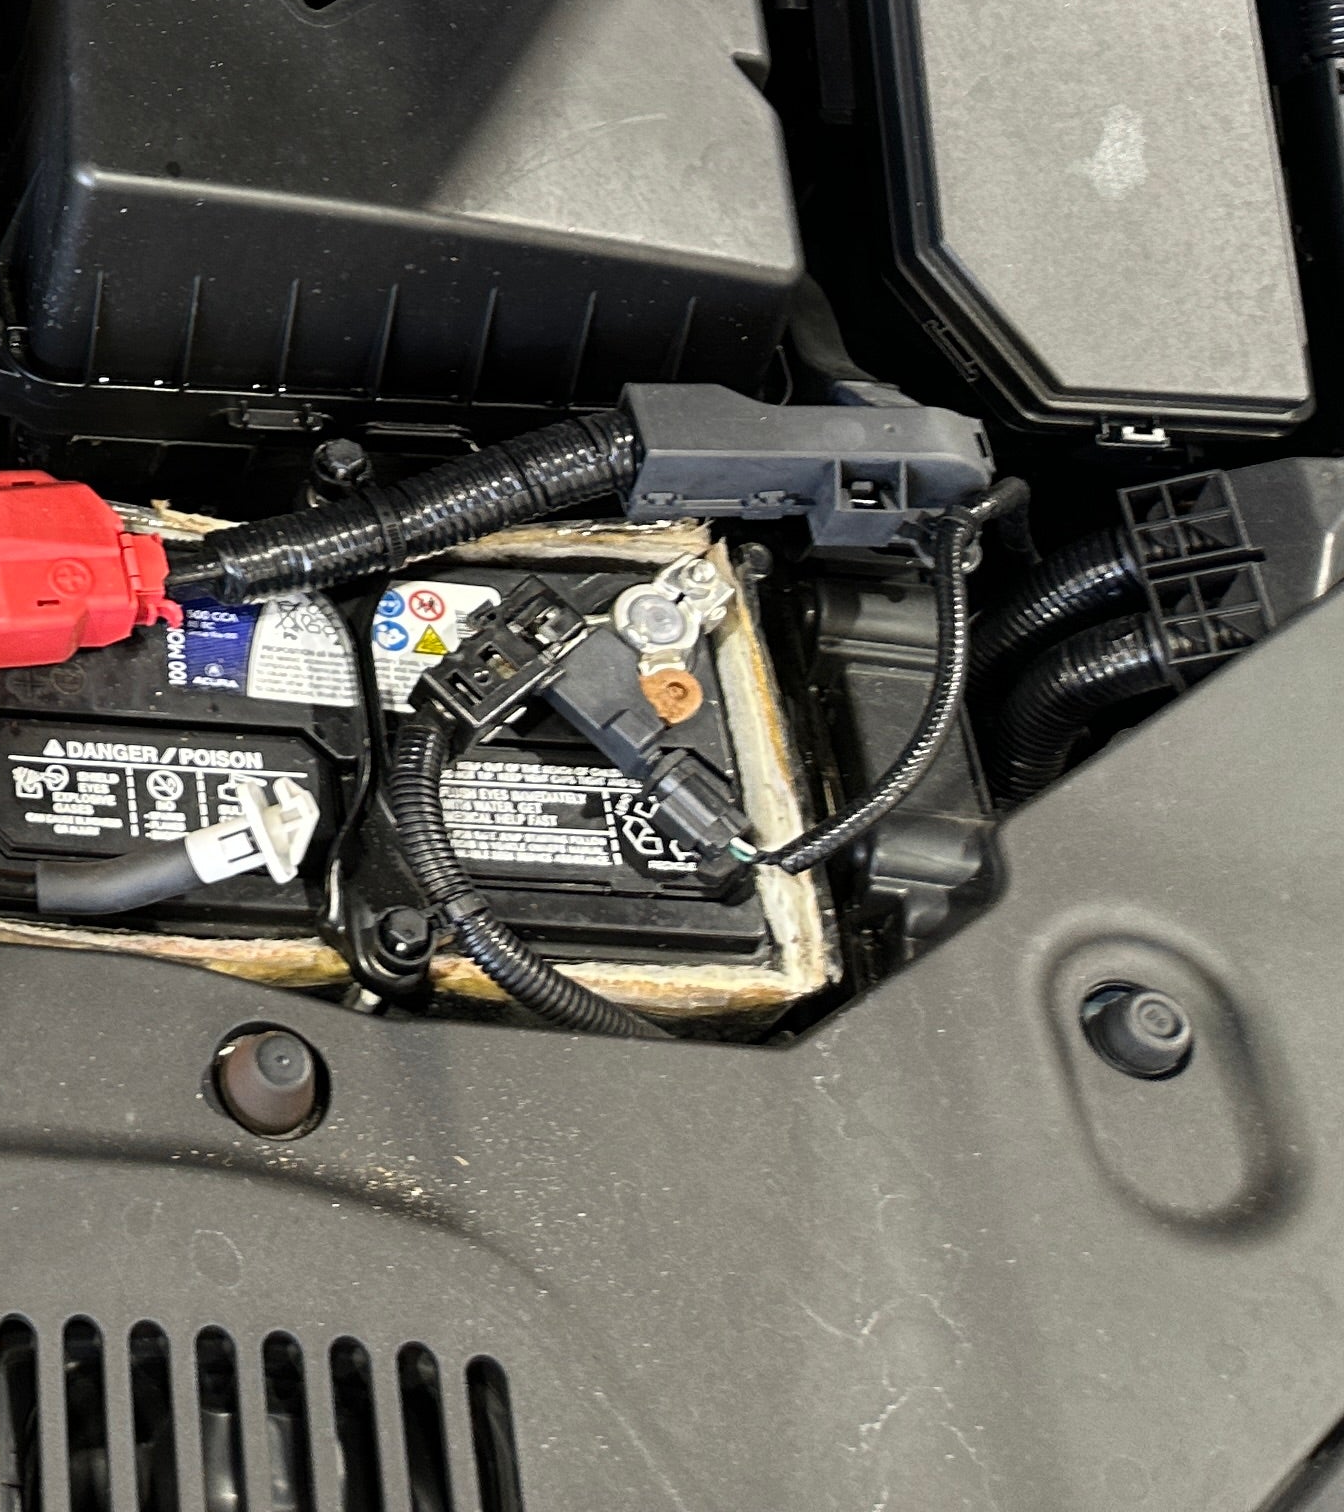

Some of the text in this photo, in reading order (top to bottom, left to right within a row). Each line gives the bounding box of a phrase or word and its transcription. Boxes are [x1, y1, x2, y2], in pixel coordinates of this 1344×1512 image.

[191, 675, 240, 690] ACURA
[66, 740, 158, 763] DANGER
[178, 747, 264, 769] POISON
[478, 788, 510, 801] EYES
[510, 790, 587, 805] IMMEDIATELY
[493, 813, 527, 825] HELP
[526, 814, 559, 827] FAST
